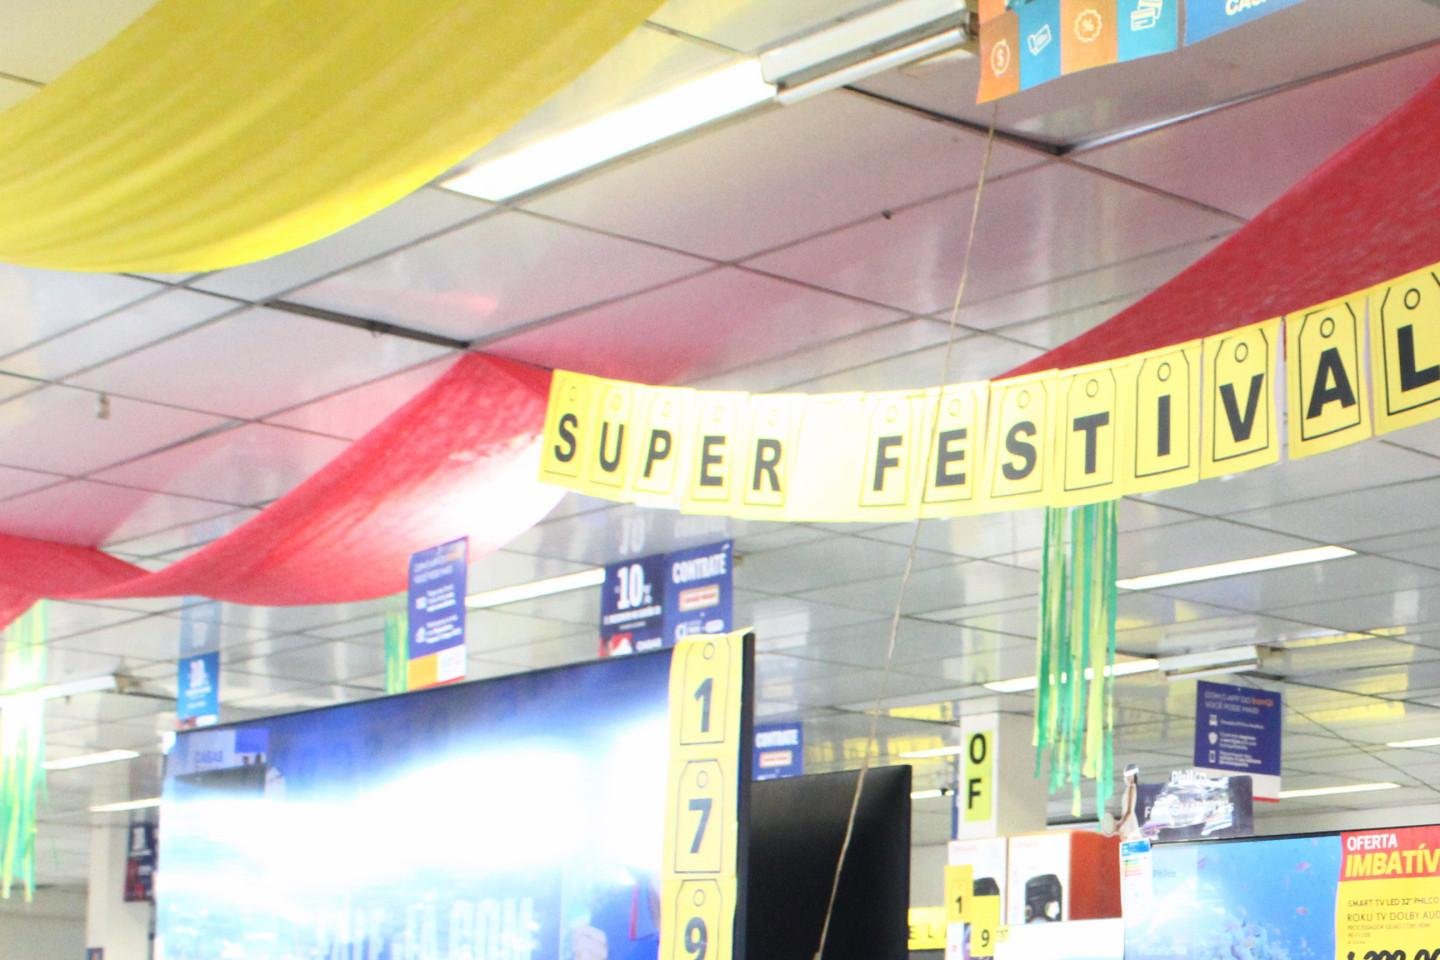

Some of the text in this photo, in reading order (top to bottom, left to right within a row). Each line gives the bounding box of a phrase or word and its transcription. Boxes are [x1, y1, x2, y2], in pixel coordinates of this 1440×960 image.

[554, 413, 782, 492] SUPER
[1346, 833, 1399, 852] OFERTA
[1347, 912, 1373, 922] ROKU
[1376, 912, 1386, 921] TV
[1390, 911, 1420, 921] DOLBY
